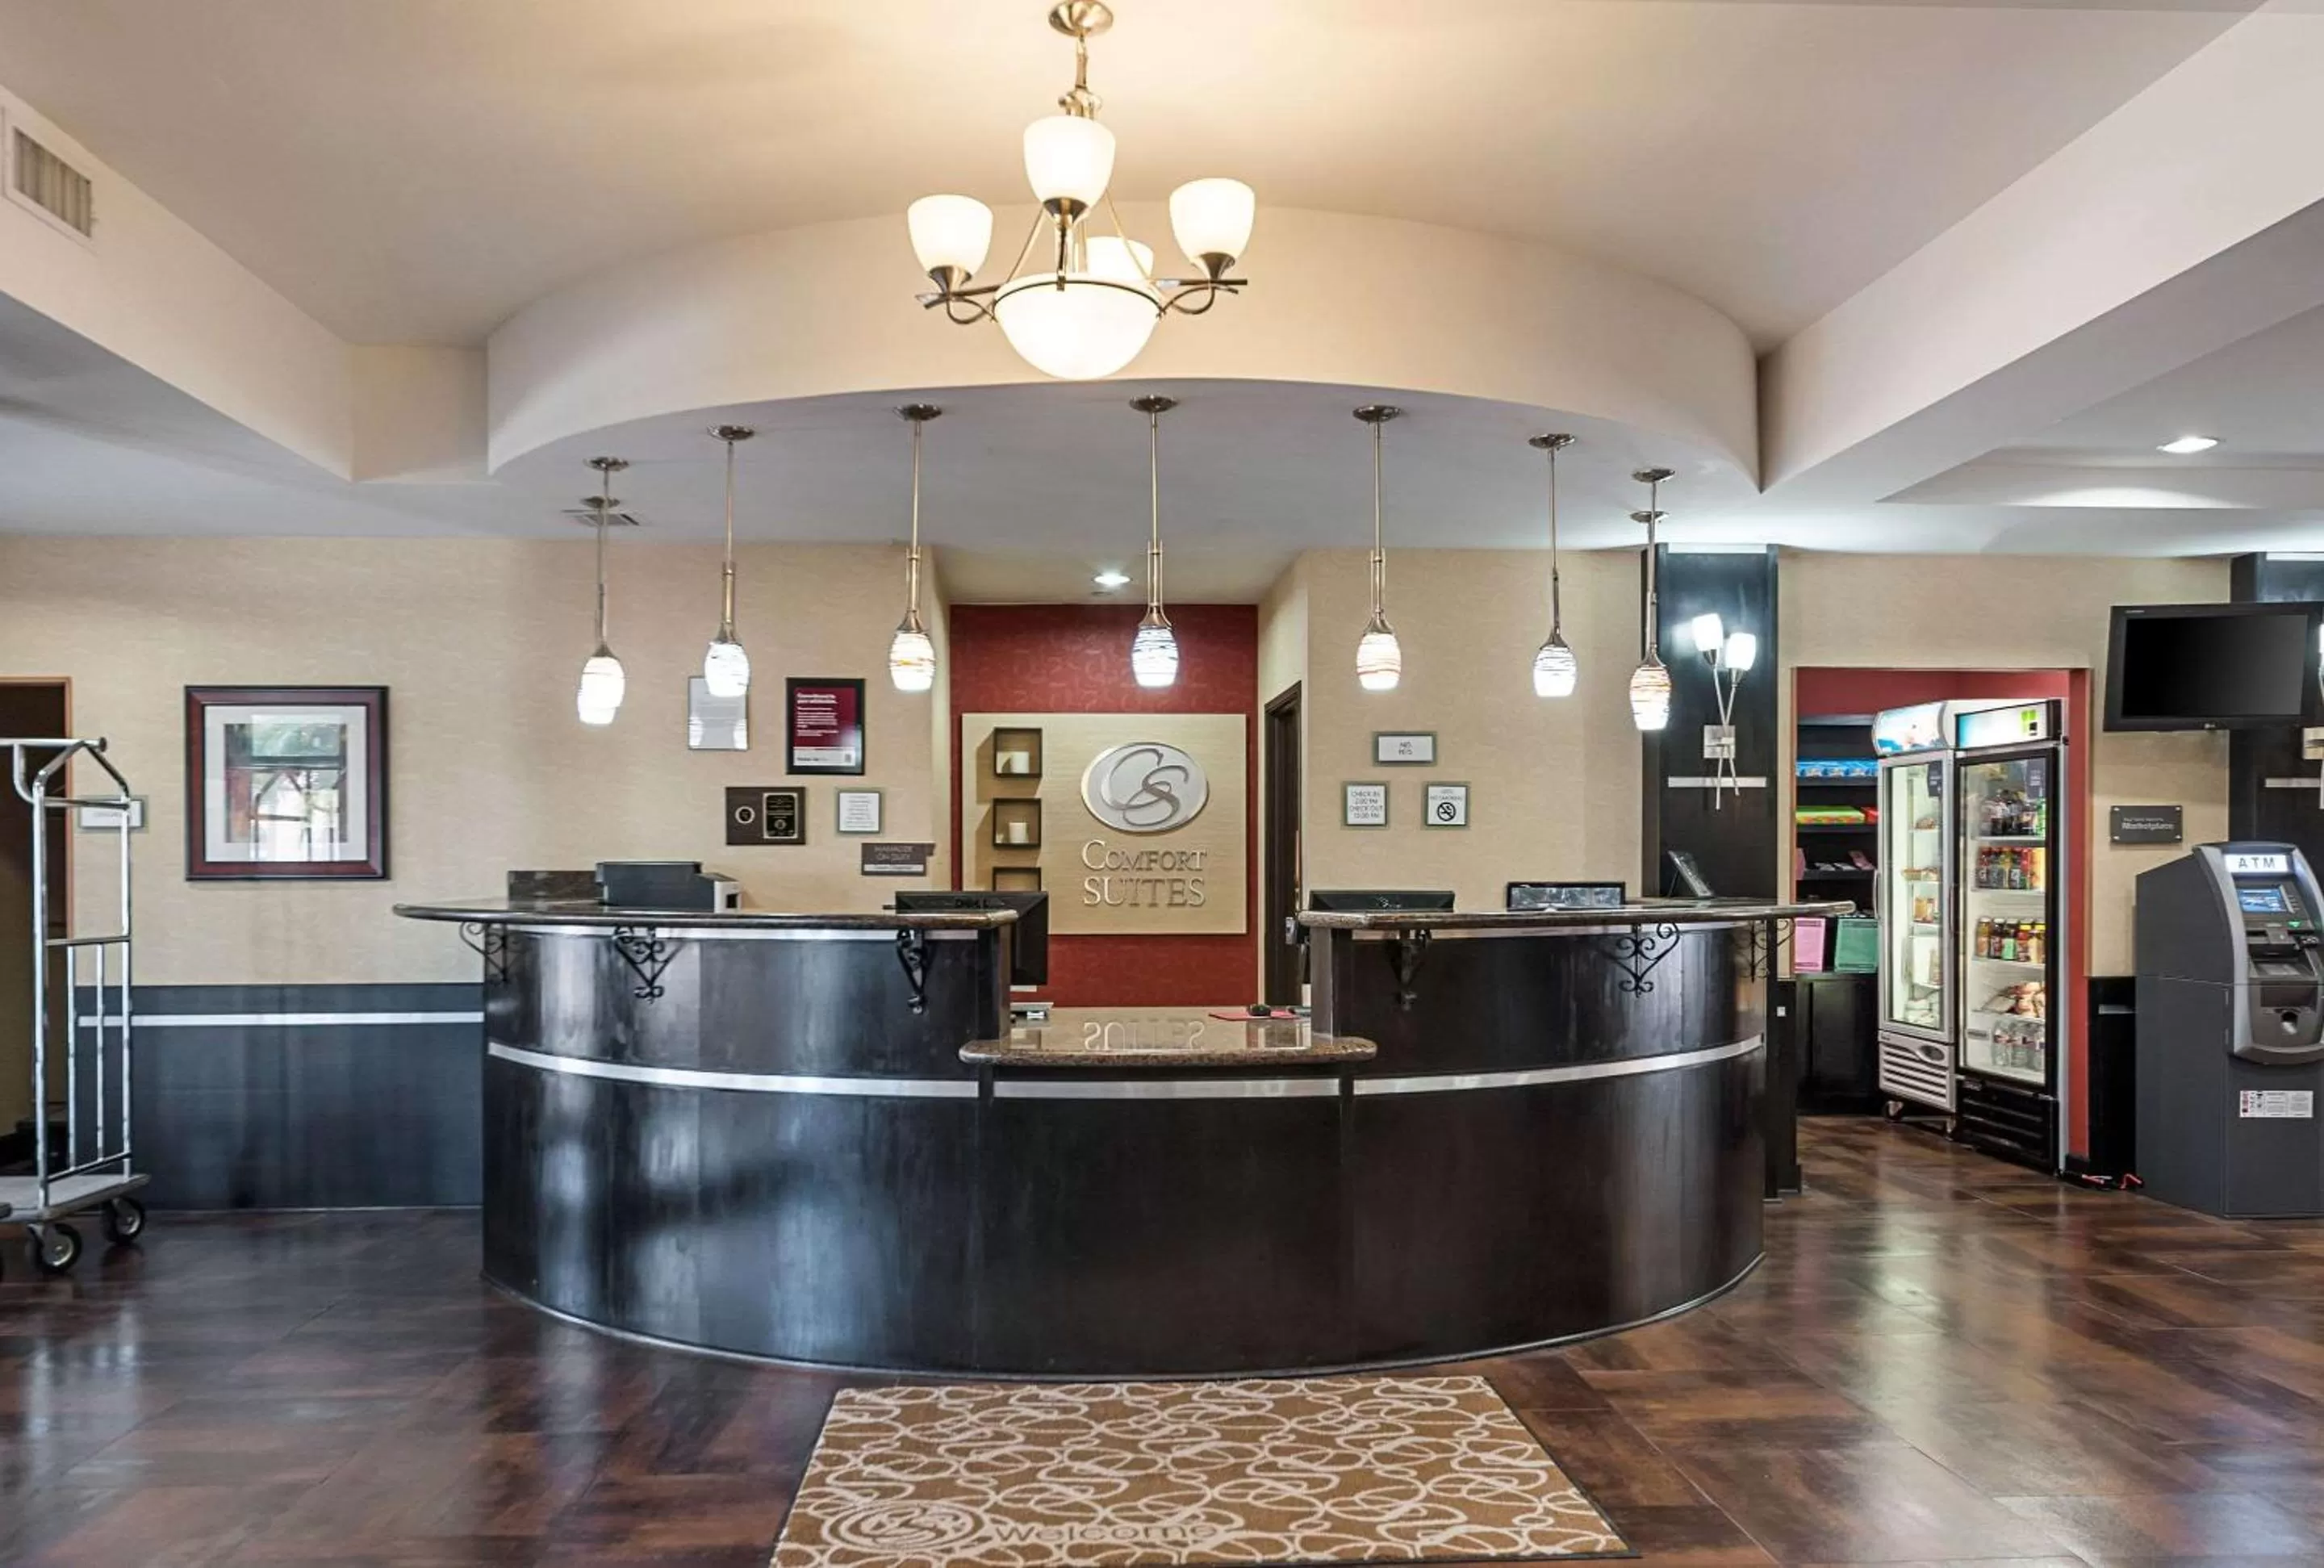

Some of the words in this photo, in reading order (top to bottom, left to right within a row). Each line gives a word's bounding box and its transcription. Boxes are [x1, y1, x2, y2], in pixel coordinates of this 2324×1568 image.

[1082, 839, 1206, 872] COMFORT
[2238, 856, 2276, 869] ATM
[1083, 876, 1207, 908] SUITES
[996, 1525, 1217, 1542] Welcome
